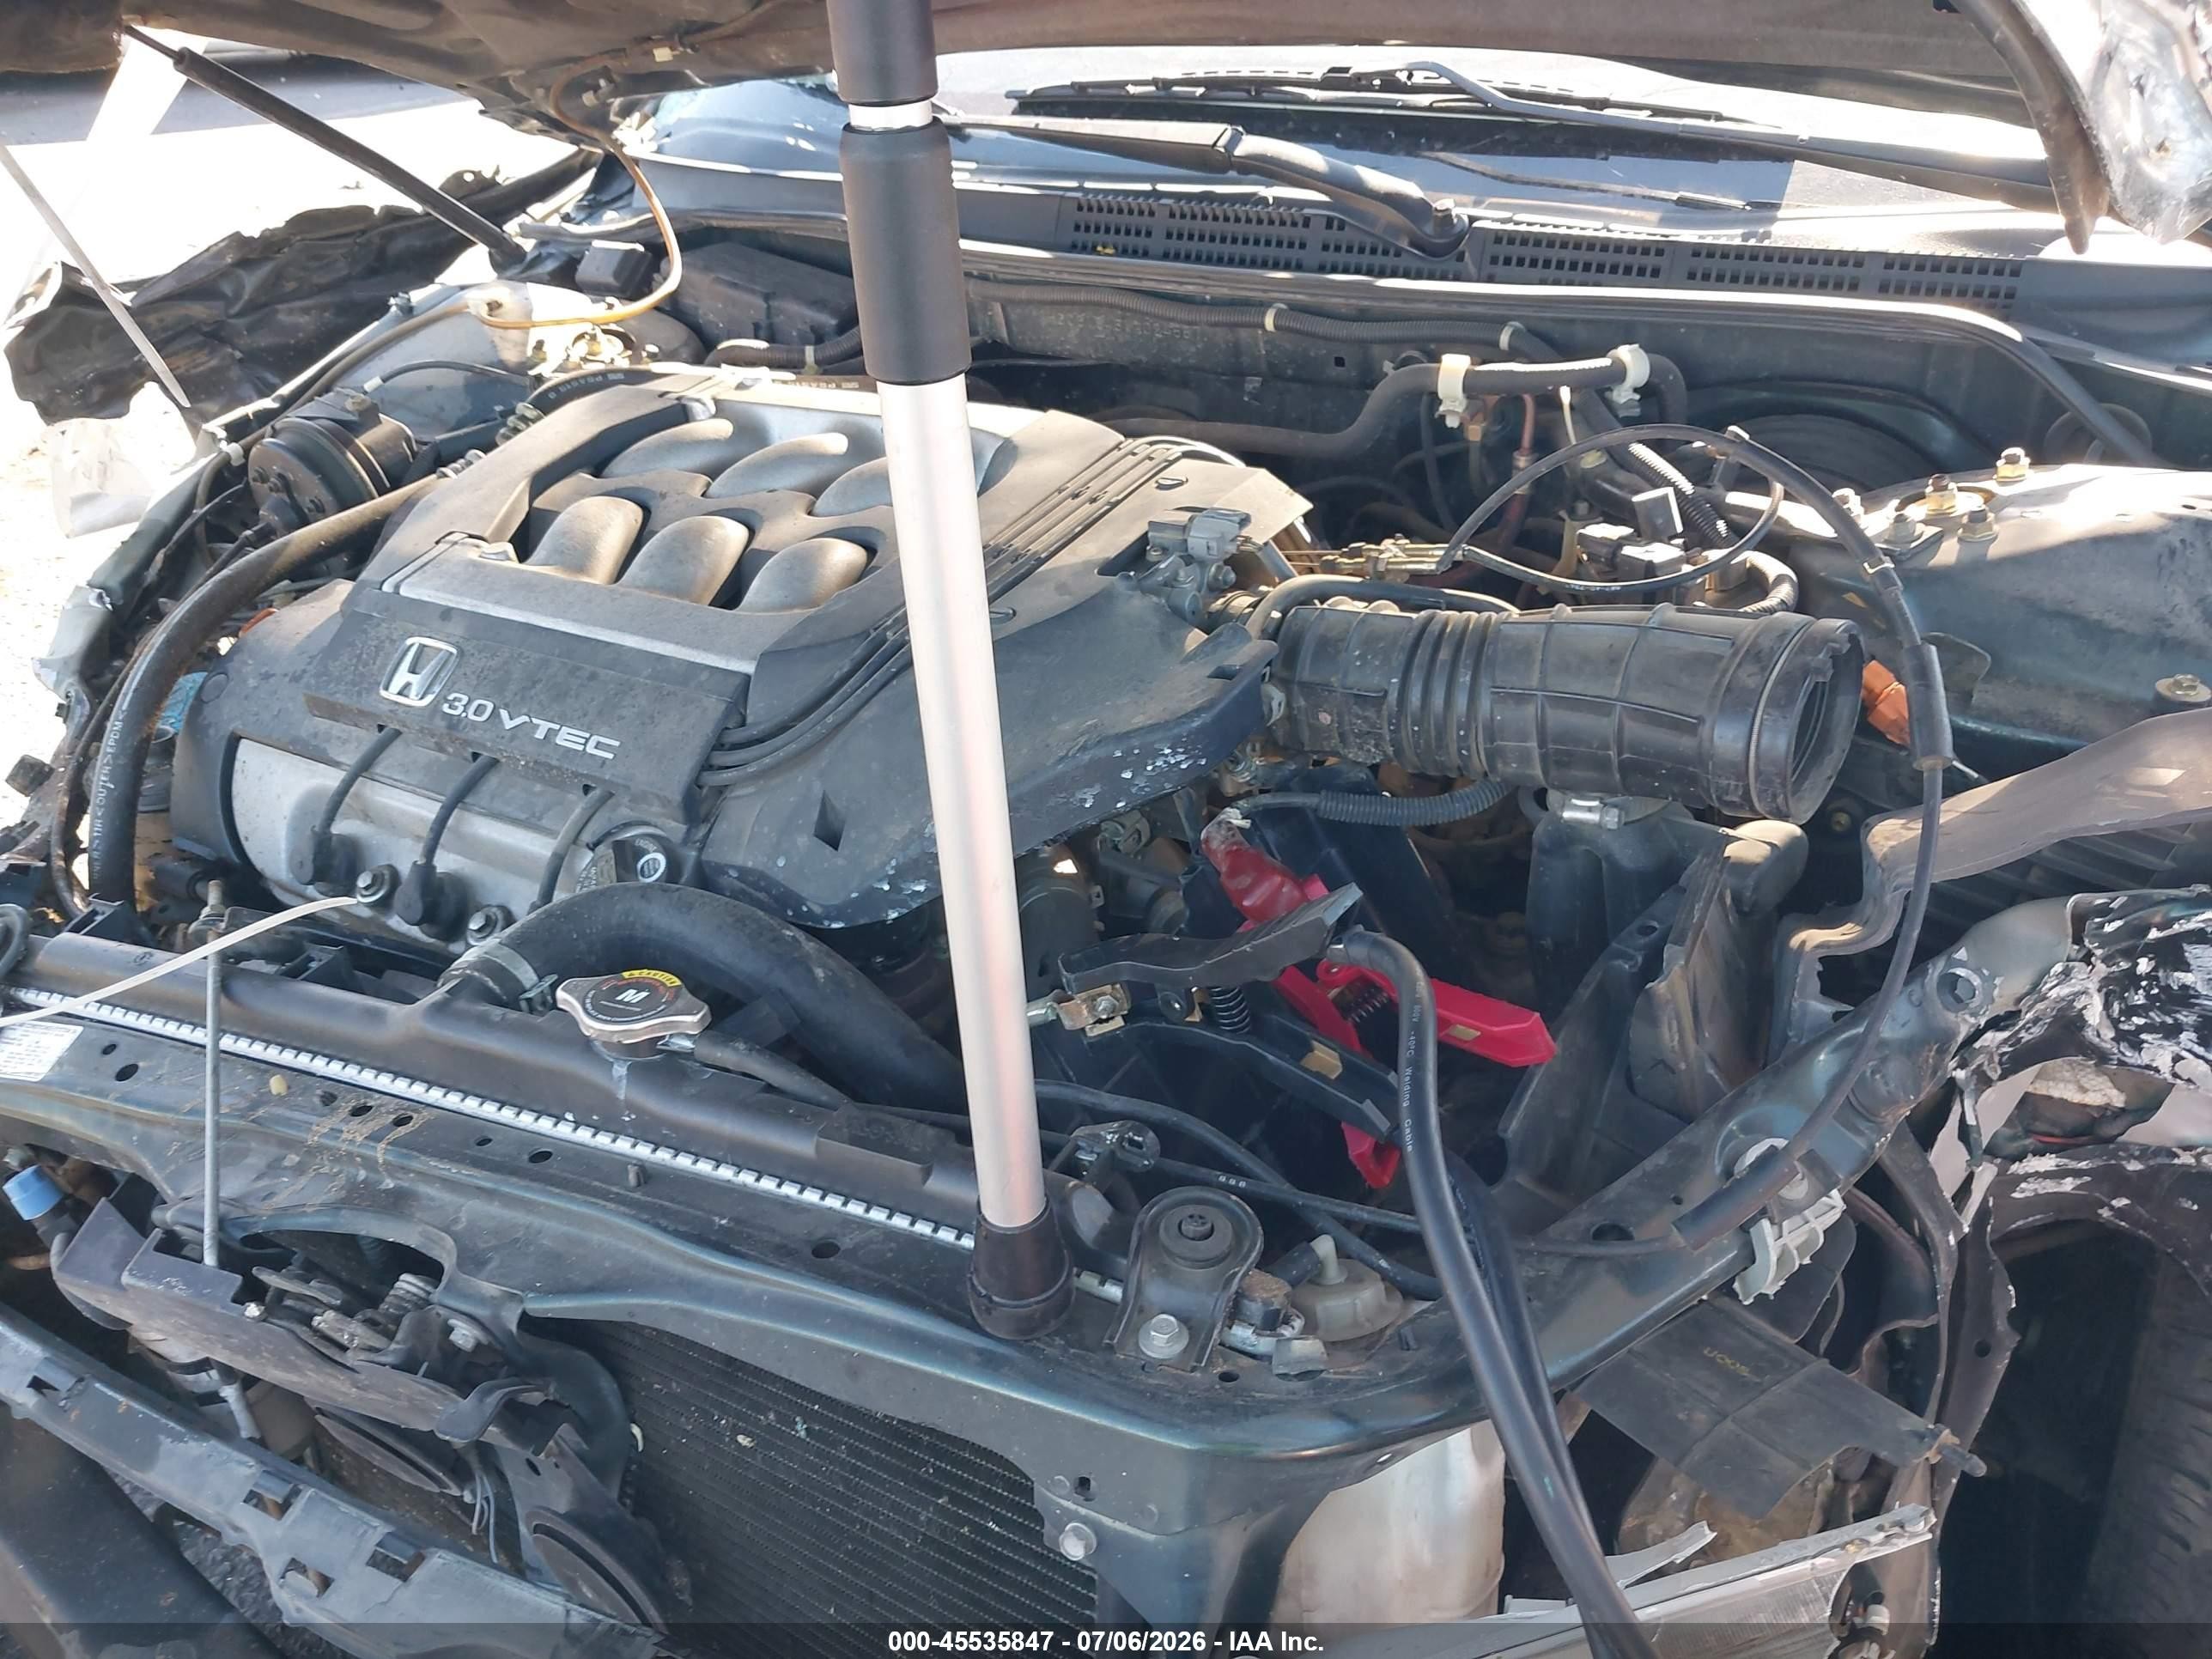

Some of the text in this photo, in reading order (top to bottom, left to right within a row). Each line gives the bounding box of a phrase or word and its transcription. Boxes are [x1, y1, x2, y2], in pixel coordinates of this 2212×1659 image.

[442, 692, 620, 759] 3.0 VTEC
[1402, 1067, 1413, 1107] Welding
[1404, 1119, 1413, 1152] Cable
